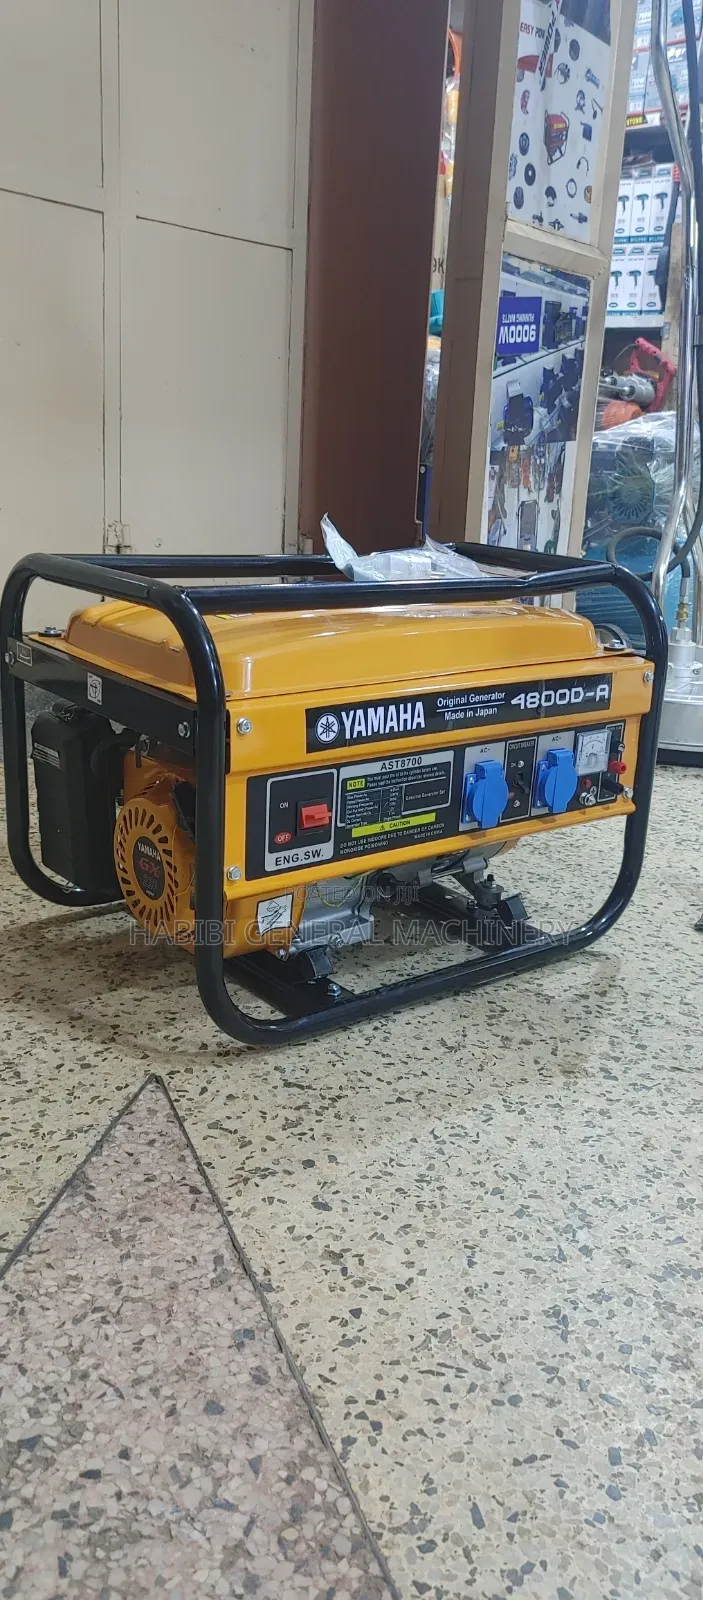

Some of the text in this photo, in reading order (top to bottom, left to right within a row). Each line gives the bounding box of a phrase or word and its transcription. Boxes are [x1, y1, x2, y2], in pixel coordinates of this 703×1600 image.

[520, 22, 534, 36] EASY
[539, 10, 557, 77] POWER
[498, 324, 536, 344] 9000W
[437, 692, 506, 707] Original Generator
[511, 684, 609, 710] 4800D-A
[341, 701, 426, 740] YAMAHA
[445, 707, 498, 721] Made in Japan
[380, 756, 422, 771] AST8700
[349, 780, 363, 788] NOTE
[389, 820, 410, 830] CAUTION
[277, 834, 289, 842] OFF
[348, 839, 357, 847] NOT
[137, 841, 161, 862] YAMAHA
[275, 848, 324, 866] ENG.SW.
